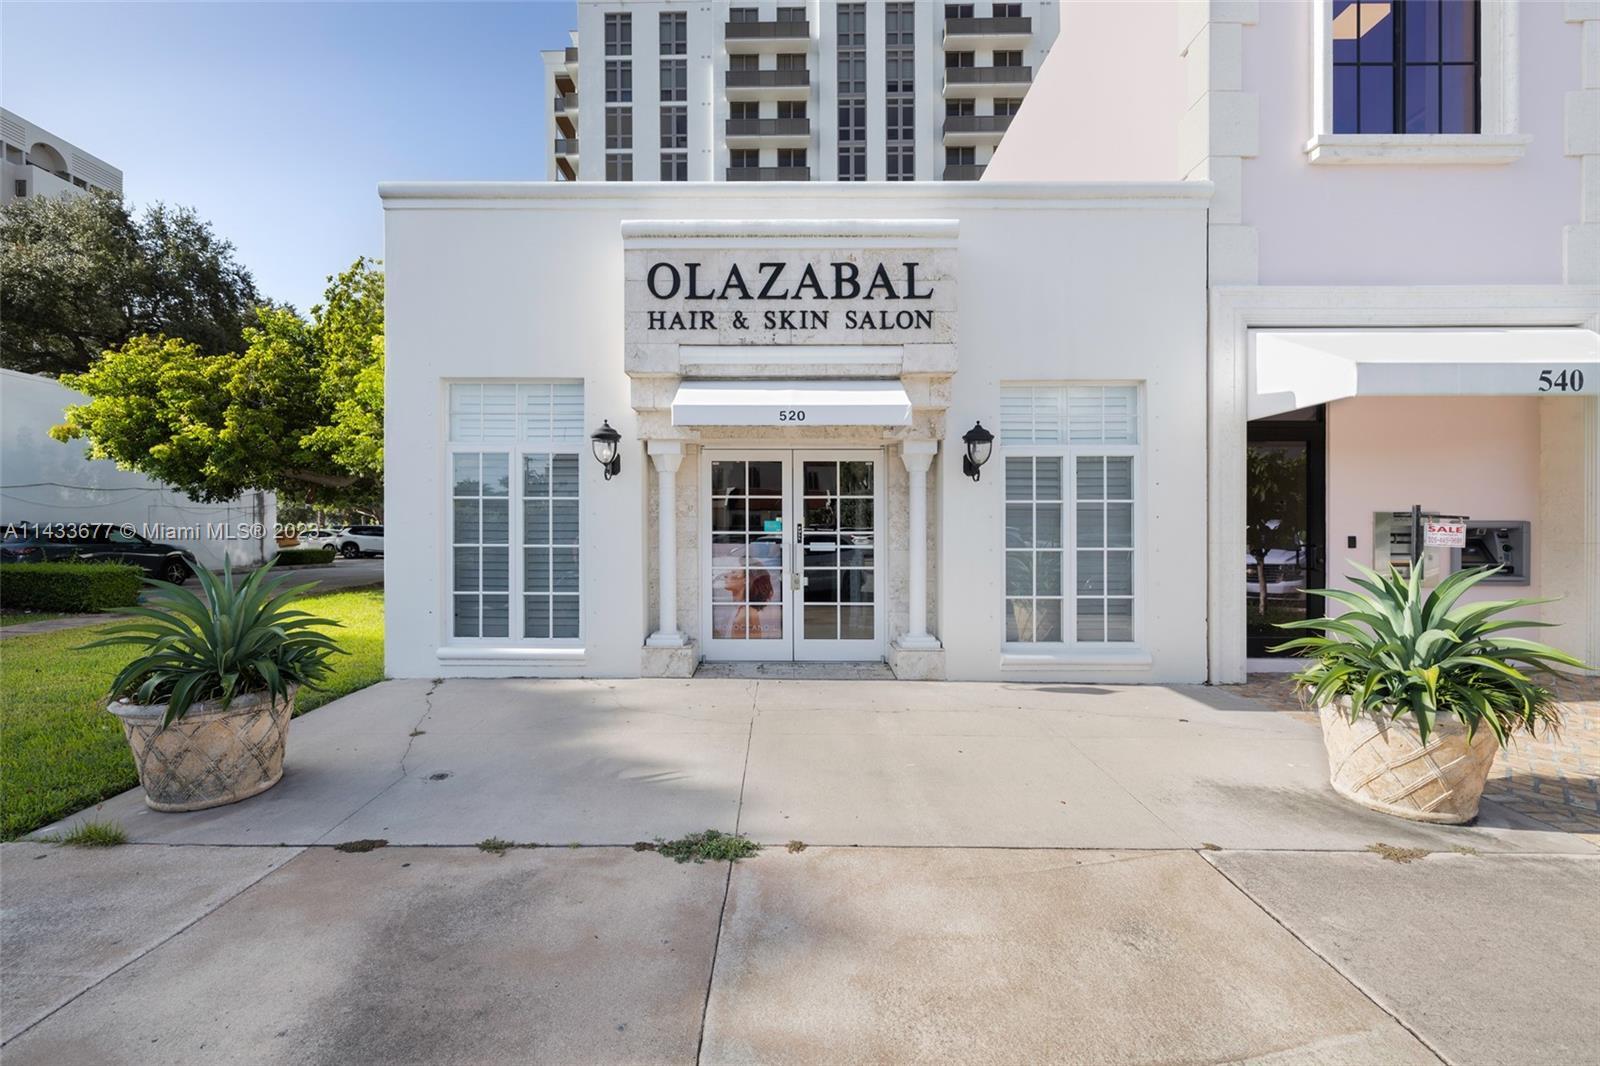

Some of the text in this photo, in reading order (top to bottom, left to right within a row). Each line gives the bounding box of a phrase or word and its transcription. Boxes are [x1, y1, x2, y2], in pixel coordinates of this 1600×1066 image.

[647, 262, 933, 300] OLAZABAL
[648, 310, 933, 330] HAIR & SKIN SALON
[1538, 369, 1584, 392] 540
[779, 410, 806, 421] 520
[1428, 525, 1463, 533] SALE
